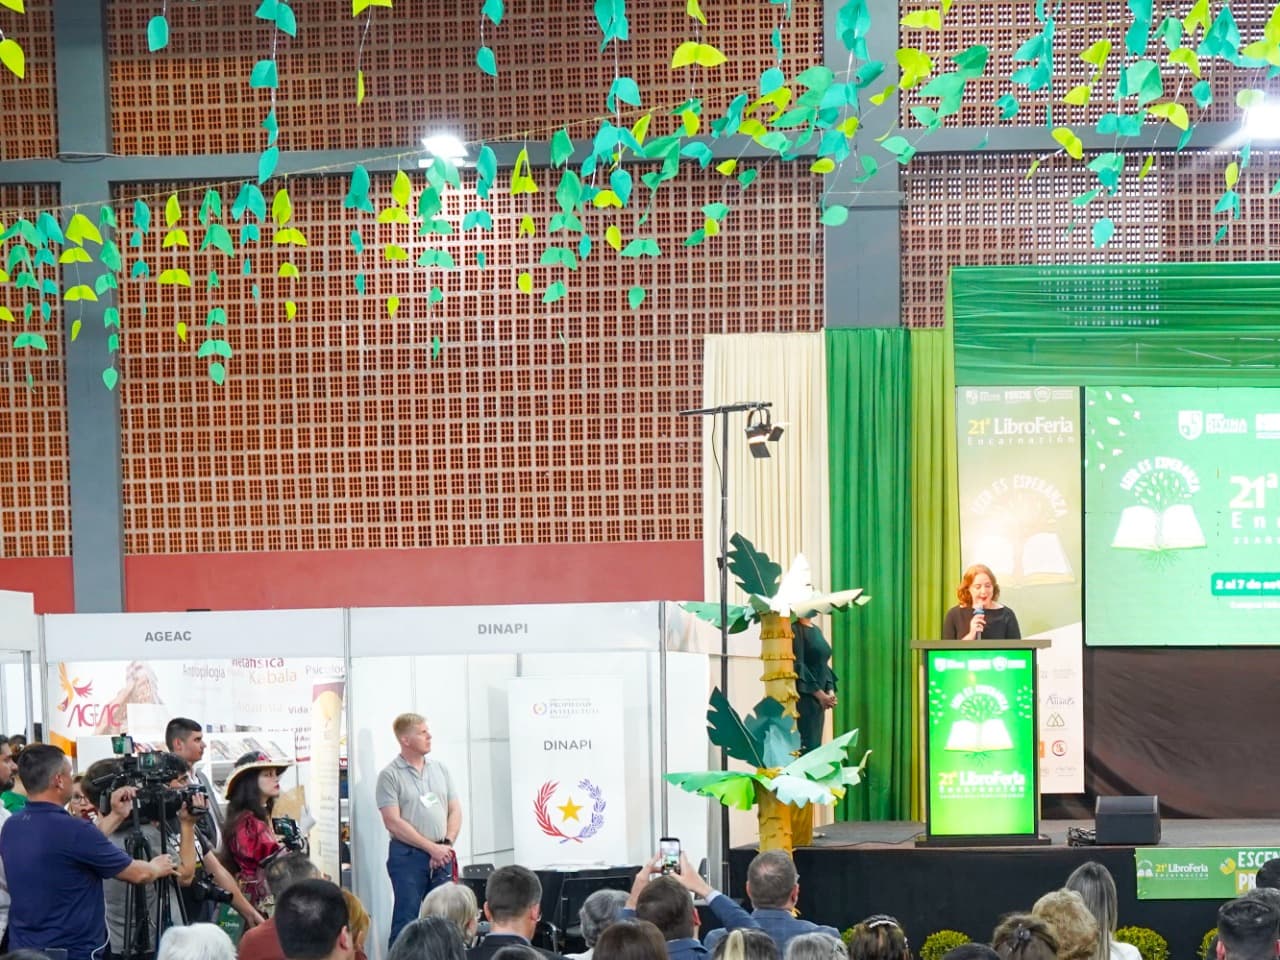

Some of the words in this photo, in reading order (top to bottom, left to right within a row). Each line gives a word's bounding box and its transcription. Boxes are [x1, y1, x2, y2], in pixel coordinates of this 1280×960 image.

[993, 416, 1074, 435] LibroFeria
[1229, 473, 1278, 508] 21ª
[478, 623, 528, 635] DINAPI
[144, 630, 192, 643] AGEAC
[543, 740, 592, 751] DINAPI
[1168, 863, 1209, 873] LibroFeria
